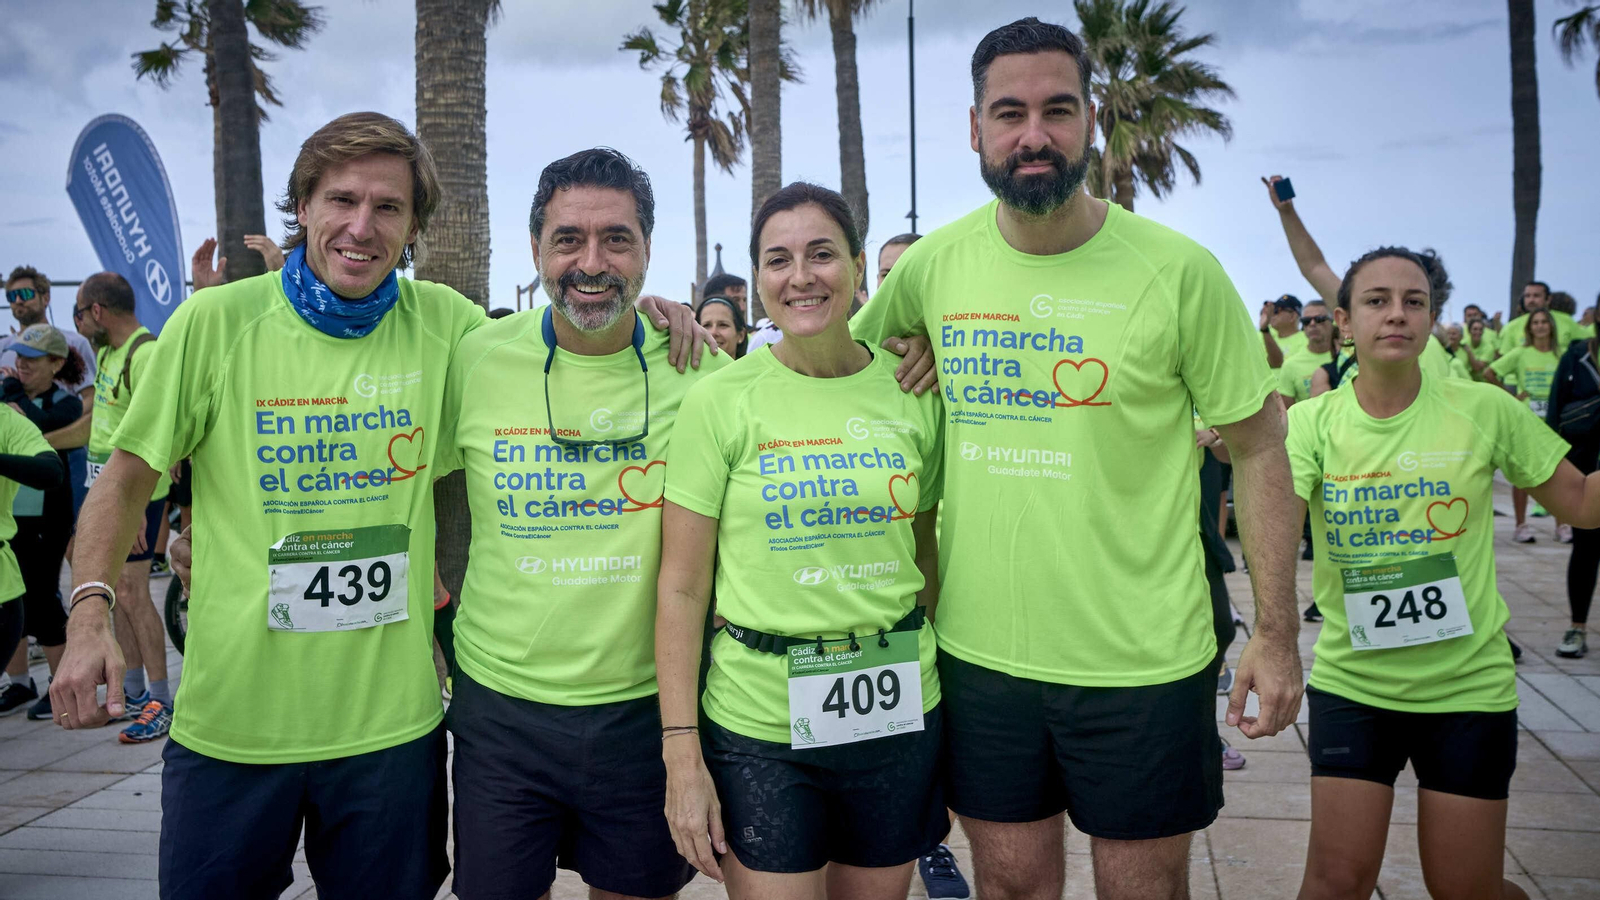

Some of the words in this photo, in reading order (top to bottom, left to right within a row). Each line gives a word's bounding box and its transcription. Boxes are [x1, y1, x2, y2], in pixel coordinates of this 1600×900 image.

[949, 312, 970, 322] CÁDIZ
[982, 313, 1021, 322] MARCHA
[941, 325, 966, 348] En
[972, 327, 1084, 354] marcha
[942, 352, 1022, 378] contra
[256, 399, 265, 407] IX
[267, 398, 296, 407] CÁDIZ
[312, 396, 348, 405] MARCHA
[945, 379, 958, 404] el
[963, 380, 1062, 409] cáncer
[256, 411, 295, 434] En
[305, 405, 412, 434] marcha
[966, 411, 994, 419] ESPAÑOLA
[994, 413, 1018, 421] CONTRA
[1028, 414, 1053, 423] CÁNCER
[495, 428, 502, 436] IX
[503, 426, 527, 436] CÁDIZ
[257, 439, 357, 463] contra
[493, 440, 525, 463] En
[535, 442, 647, 463] marcha
[758, 443, 766, 451] IX
[768, 439, 792, 449] CÁDIZ
[792, 439, 805, 448] EN
[806, 437, 843, 446] MARCHA
[759, 453, 796, 476] En
[802, 447, 906, 470] marcha
[988, 446, 1072, 468] HYUNDAI
[259, 468, 290, 492] el
[297, 467, 396, 492] cáncer
[494, 467, 586, 491] contra
[988, 465, 1040, 478] Guadalete
[1042, 468, 1072, 481] Motor
[1361, 471, 1391, 479] MARCHA
[761, 474, 859, 502] contra
[1323, 482, 1348, 503] En
[1354, 477, 1451, 502] marcha
[300, 499, 332, 507] ESPAÑOLA
[366, 494, 389, 502] CÁNCER
[497, 495, 518, 518] el
[525, 495, 628, 518] cáncer
[765, 504, 794, 530] el
[800, 502, 897, 527] cáncer
[1324, 505, 1400, 525] contra
[302, 534, 315, 542] en
[317, 531, 354, 541] marcha
[527, 524, 559, 532] ESPAÑOLA
[1326, 528, 1343, 547] el
[1349, 528, 1436, 547] cáncer
[309, 541, 320, 550] el
[321, 540, 355, 550] cáncer
[768, 536, 803, 544] ASOCIACIÓN
[804, 533, 831, 542] ESPAÑOLA
[832, 532, 856, 540] CONTRA
[552, 556, 642, 573] HYUNDAI
[830, 560, 900, 579] HYUNDAI
[304, 561, 391, 607] 439
[552, 576, 607, 587] Guadalete
[610, 574, 642, 583] Motor
[1377, 572, 1404, 581] cáncer
[1370, 586, 1447, 628] 248
[791, 646, 816, 657] Cádiz
[793, 655, 823, 665] contra
[824, 653, 834, 662] el
[835, 650, 863, 661] cáncer
[822, 669, 900, 719] 409
